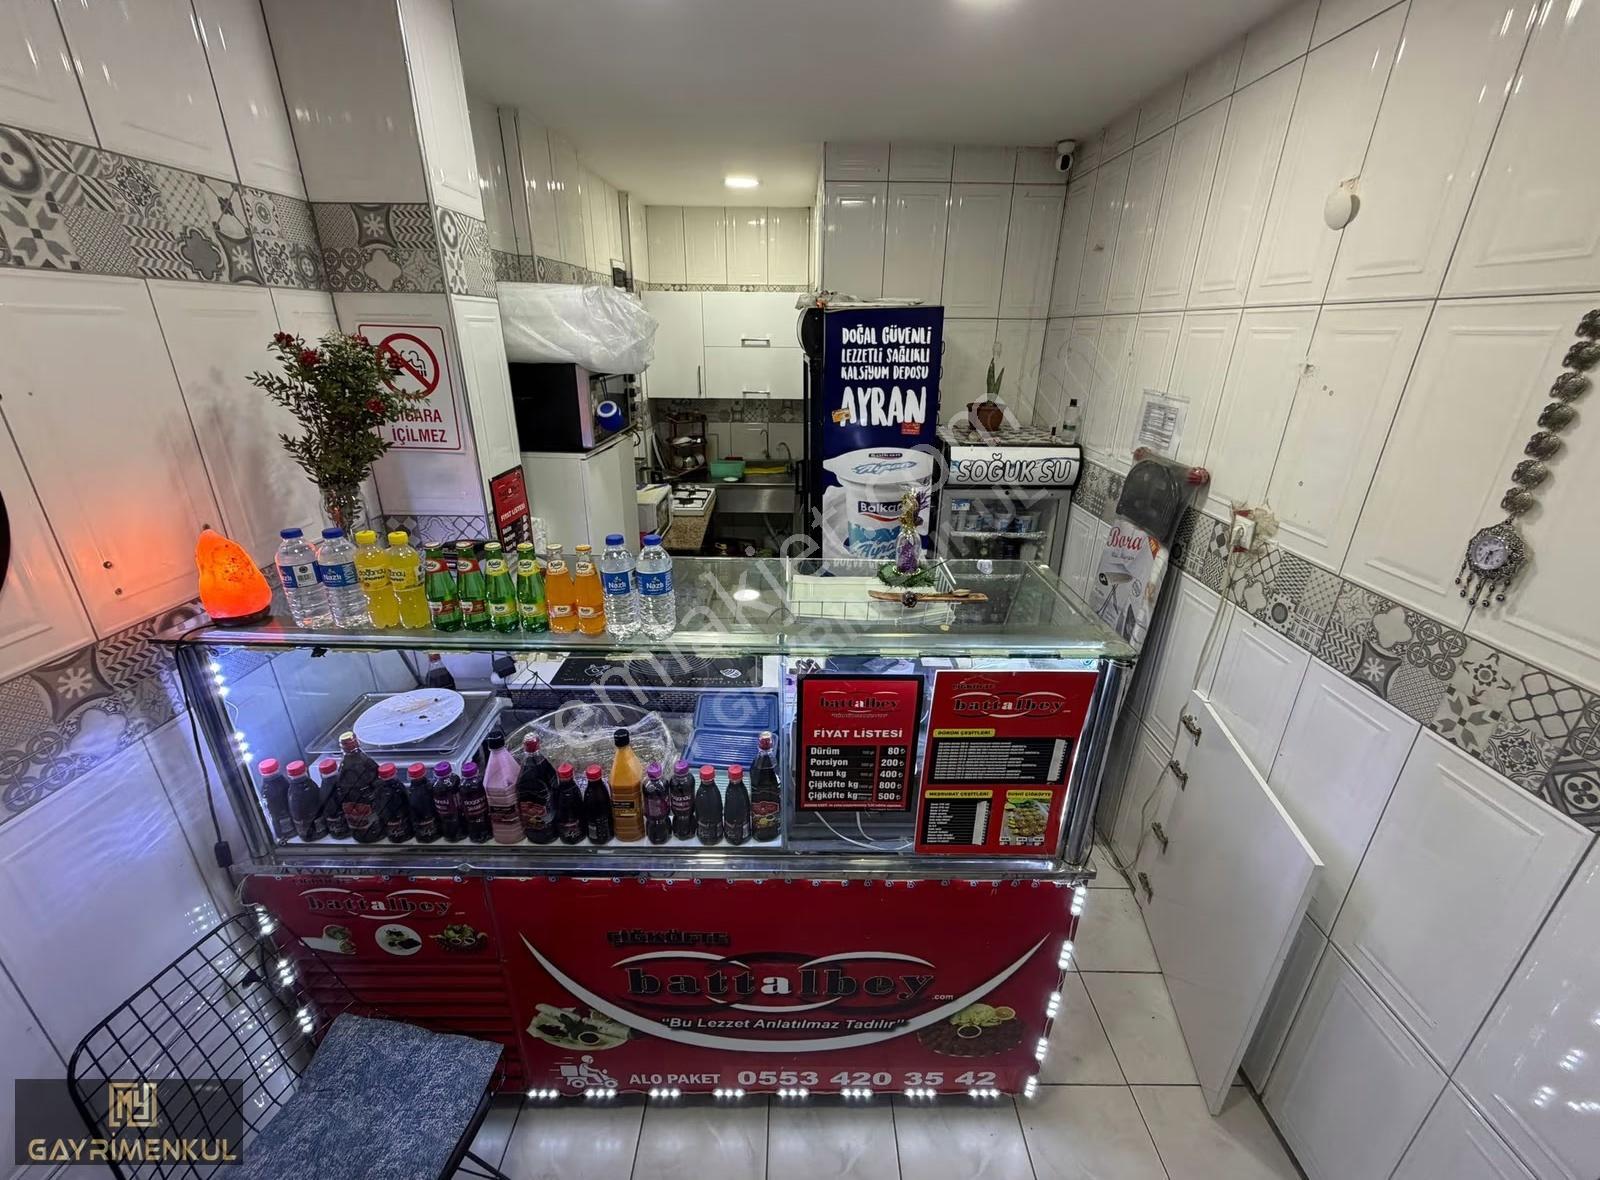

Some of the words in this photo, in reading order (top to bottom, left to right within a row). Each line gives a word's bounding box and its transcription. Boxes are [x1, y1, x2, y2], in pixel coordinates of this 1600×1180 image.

[841, 324, 877, 345] DOĞAL
[882, 325, 932, 344] GÜVENLİ
[841, 347, 883, 363] LEZZETLİ
[886, 345, 930, 363] SAĞLIKLI
[841, 366, 889, 380] KALSİYUM
[893, 366, 929, 380] DEPOSU
[840, 386, 927, 427] AYRAN
[392, 425, 447, 445] İÇİLMEZ
[957, 453, 1035, 482] SOĞUK
[1039, 459, 1072, 482] SU
[1106, 526, 1144, 551] Bora
[953, 698, 1064, 714] battalbey
[813, 728, 850, 738] FİYAT
[853, 728, 903, 738] LİSTESİ
[810, 747, 840, 755] Dürüm
[810, 758, 848, 768] Porsiyon
[836, 770, 847, 779] kg
[848, 780, 859, 790] kg
[847, 791, 858, 801] kg
[625, 966, 934, 1001] battalbey
[697, 1018, 751, 1029] Lezzet
[752, 1017, 840, 1030] Anlatılmaz
[629, 1073, 662, 1085] ALO
[667, 1073, 721, 1085] PAKET
[737, 1071, 819, 1086] 0553
[829, 1071, 893, 1086] 420
[903, 1072, 945, 1086] 35
[954, 1071, 997, 1086] 42
